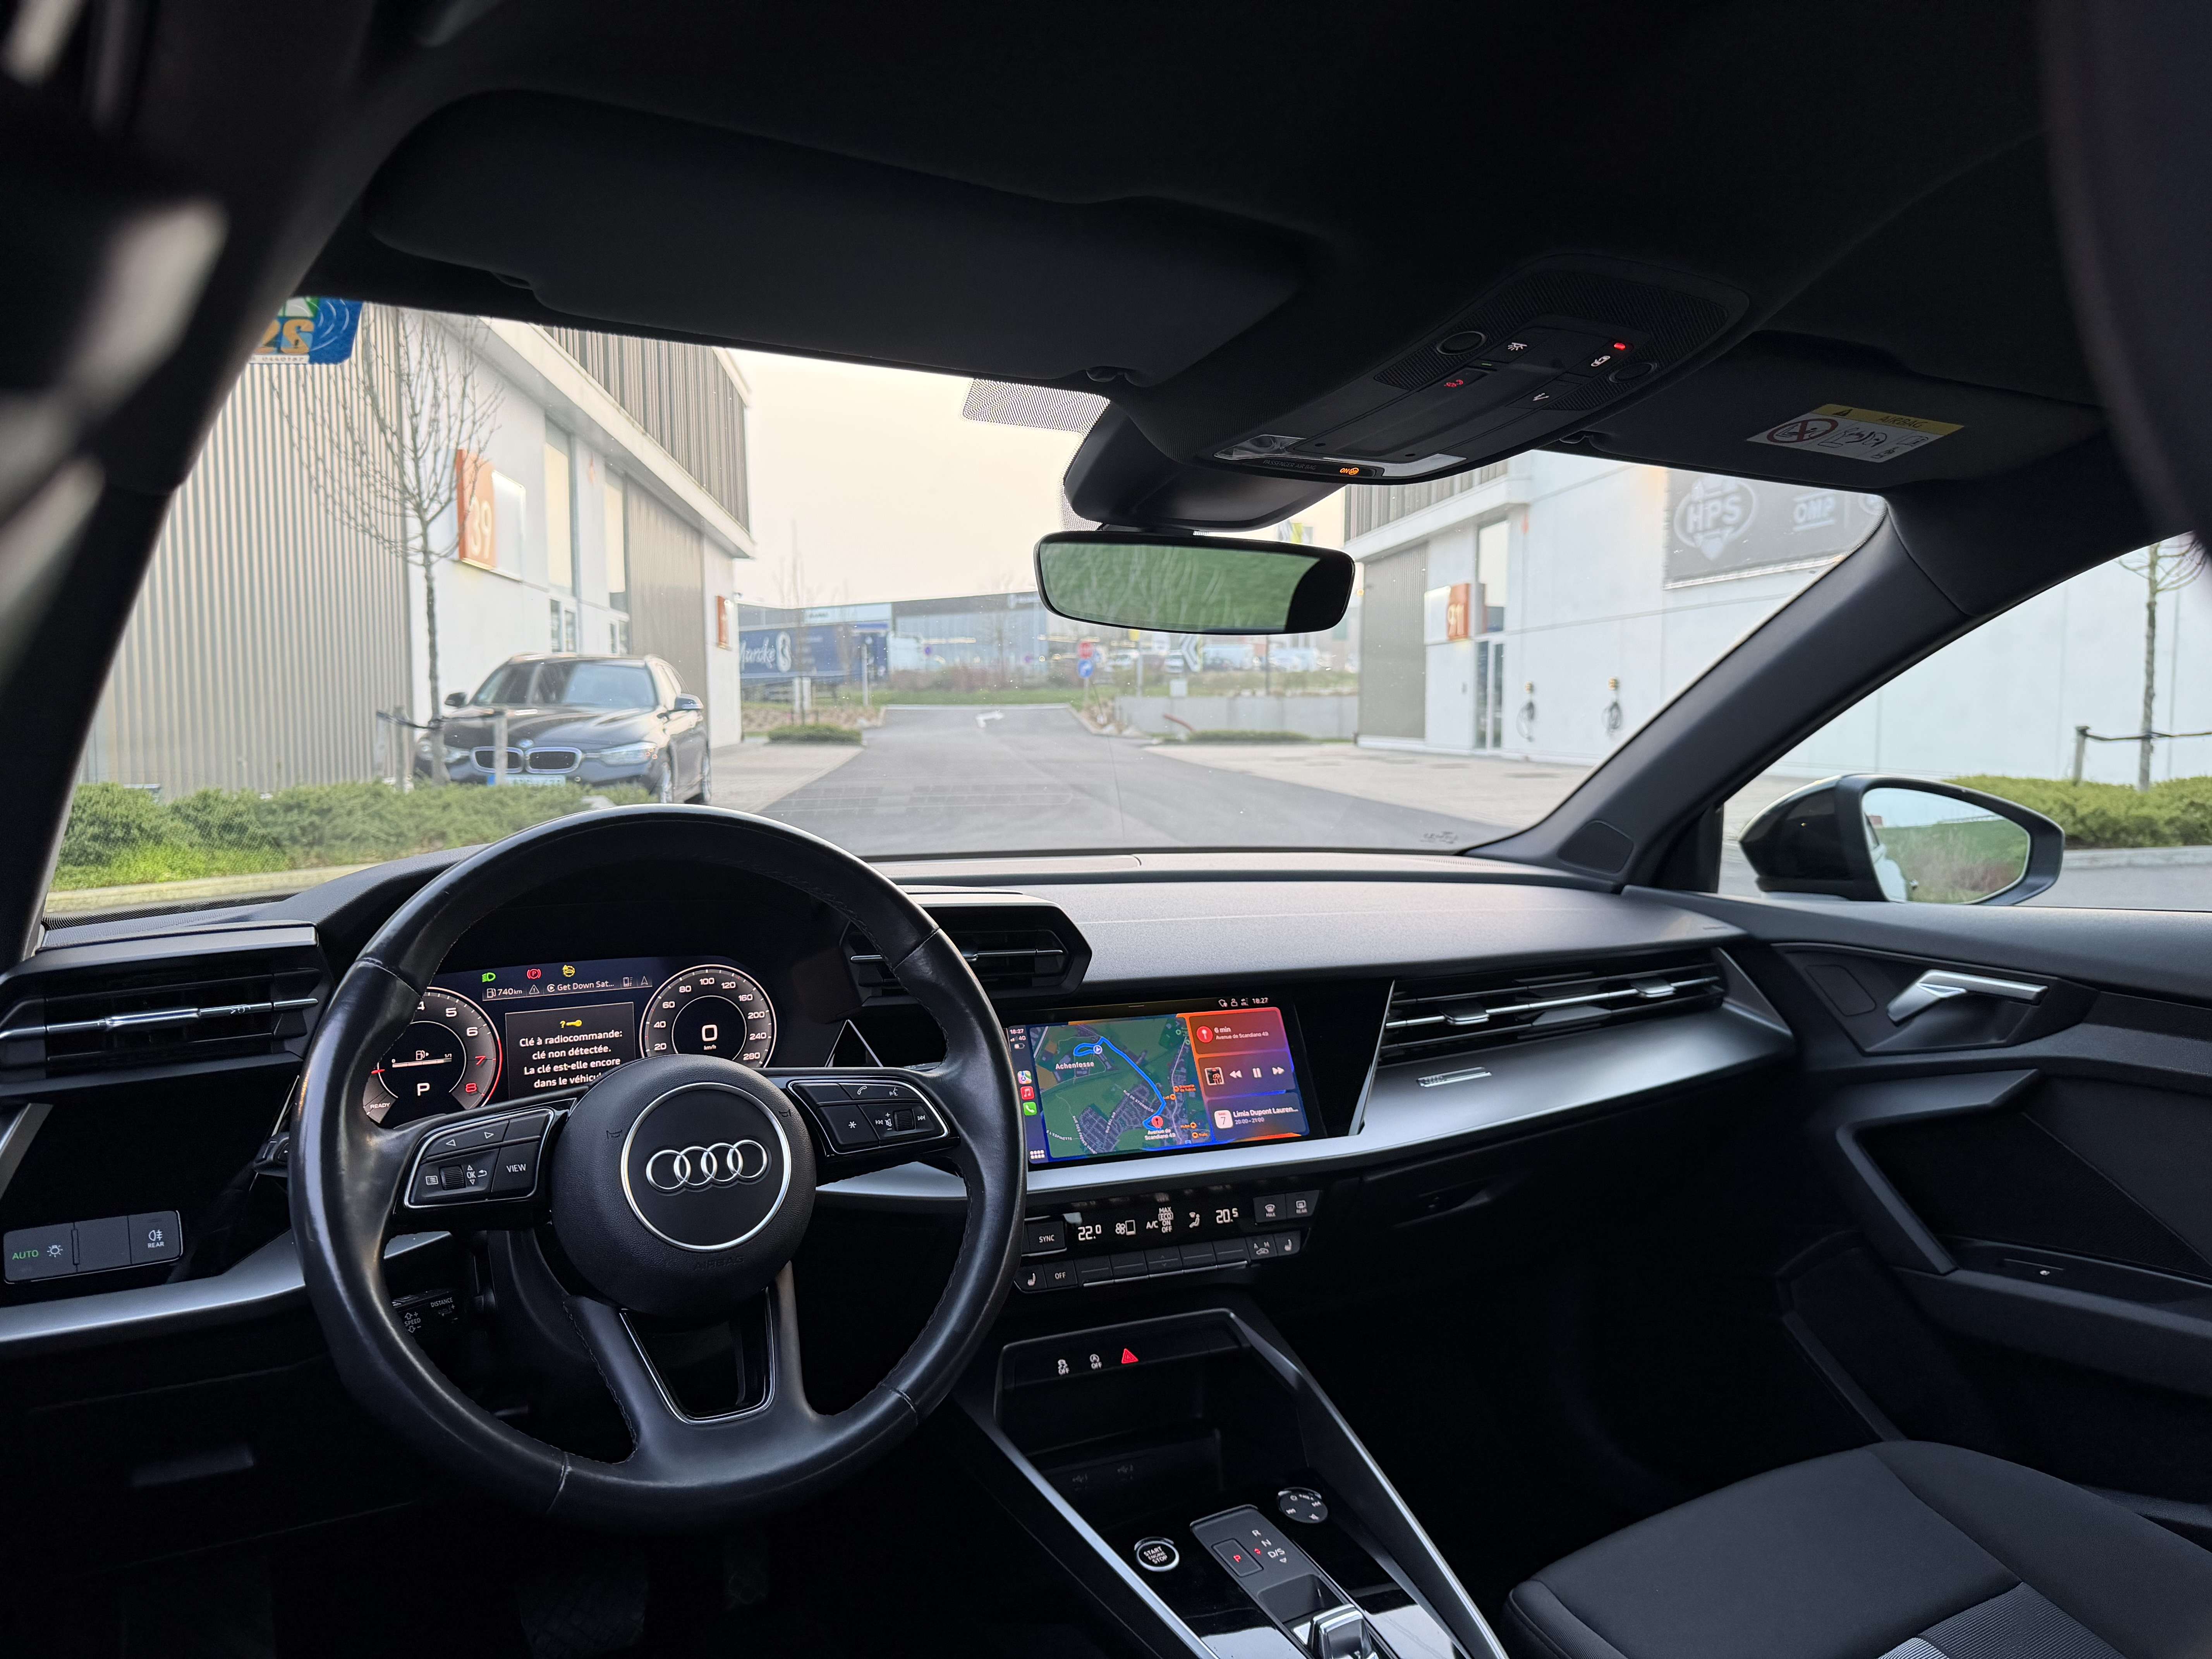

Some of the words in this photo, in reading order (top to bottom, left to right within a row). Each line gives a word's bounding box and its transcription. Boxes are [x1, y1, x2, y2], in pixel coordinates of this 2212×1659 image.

[1877, 415, 1928, 429] AIRBAG
[1263, 459, 1294, 468] PASSENGER
[1686, 494, 1742, 532] HPS
[417, 1001, 425, 1010] 4
[446, 1008, 457, 1017] 5
[467, 1027, 478, 1036] 6
[702, 1025, 718, 1041] 0
[749, 1032, 767, 1040] 240
[520, 1037, 534, 1047] Clé
[537, 1037, 542, 1045] à
[545, 1030, 622, 1044] radiocommande:
[532, 1051, 546, 1060] clé
[568, 1045, 611, 1056] détectée.
[743, 1052, 761, 1060] 280
[475, 1056, 486, 1065] 7
[524, 1067, 534, 1075] La
[537, 1065, 550, 1074] clé
[553, 1061, 587, 1072] est-elle
[590, 1058, 620, 1068] encore
[1055, 1061, 1094, 1070] Achenfosse
[534, 1079, 556, 1088] dans
[559, 1077, 567, 1085] le
[417, 1083, 430, 1096] P
[465, 1083, 477, 1092] 8
[1221, 1117, 1226, 1125] 7
[506, 1164, 526, 1173] VIEW
[1146, 1220, 1159, 1229] A/C
[1039, 1235, 1054, 1243] SYNC
[12, 1249, 39, 1261] AUTO
[431, 1297, 453, 1307] DISTANCE
[404, 1318, 421, 1327] SPEED
[1261, 1539, 1272, 1547] N
[1144, 1546, 1162, 1557] START
[1267, 1548, 1285, 1558] D/S
[1152, 1555, 1168, 1564] STOP
[1233, 1555, 1242, 1563] P
